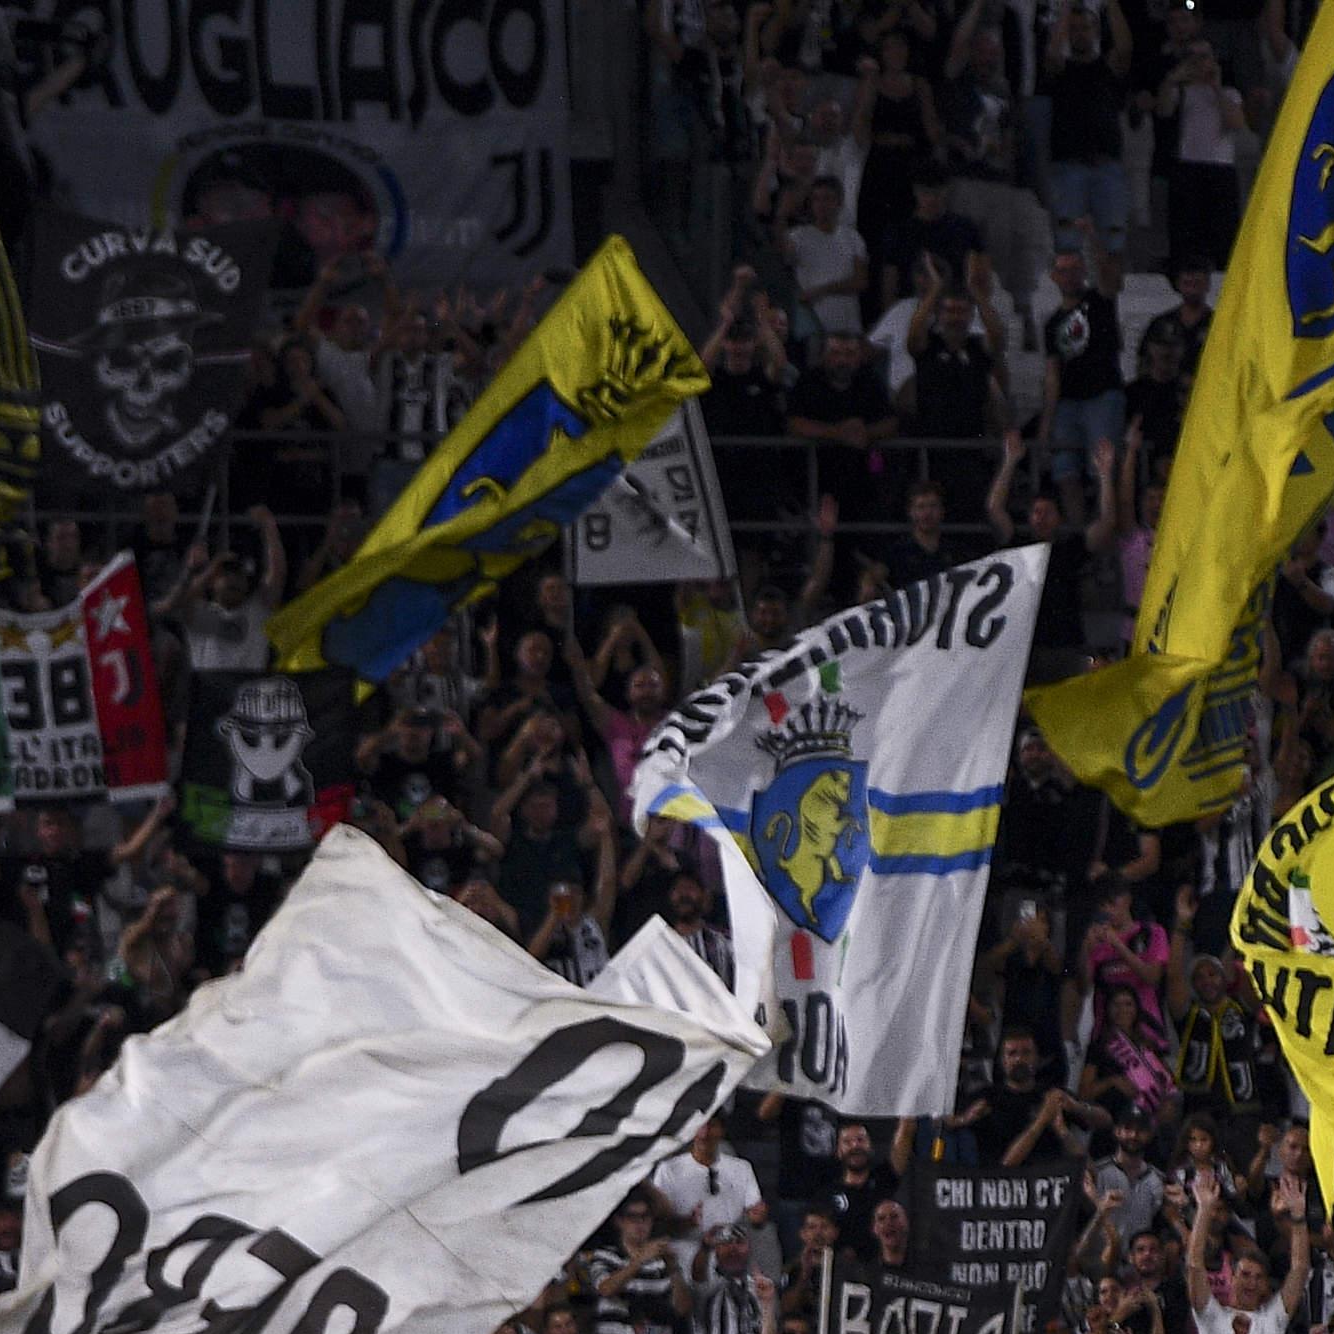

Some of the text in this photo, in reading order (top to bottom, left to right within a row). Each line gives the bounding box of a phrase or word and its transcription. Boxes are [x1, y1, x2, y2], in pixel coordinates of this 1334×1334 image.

[60, 229, 241, 291] CURVA SUD
[43, 401, 229, 488] SUPPORTERS
[1, 655, 96, 731] 38
[936, 1176, 975, 1209] CHI
[979, 1176, 1029, 1210] NON
[960, 1218, 1048, 1252] DENTRO
[951, 1260, 1002, 1285] NON
